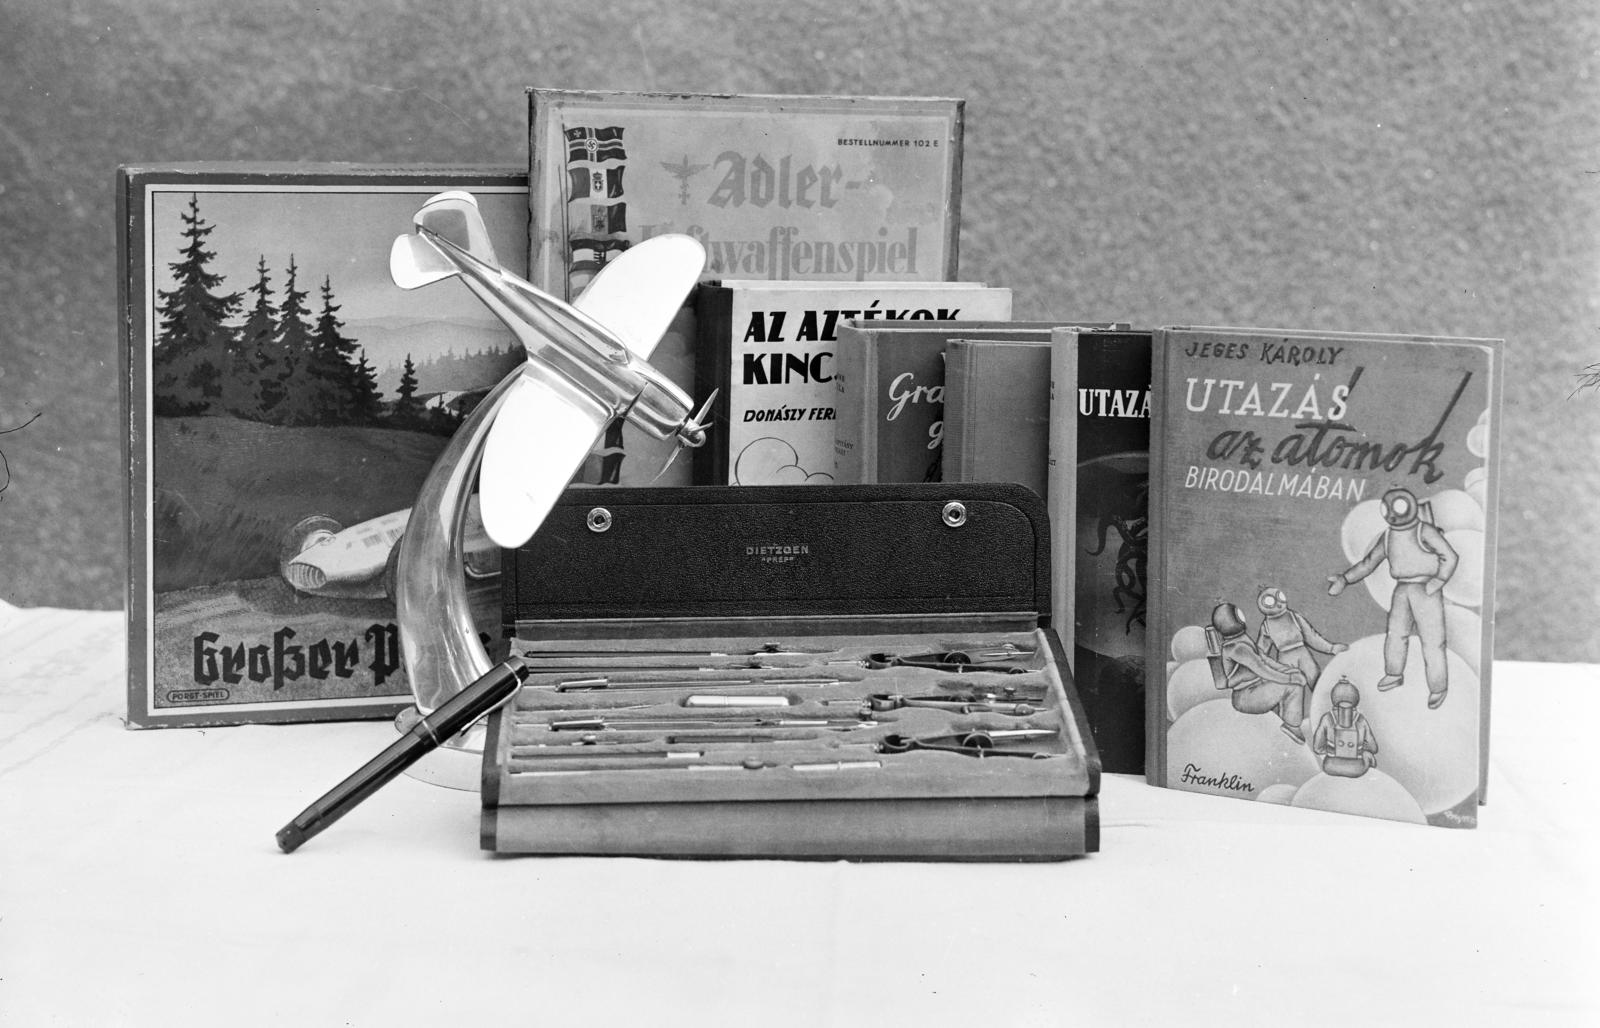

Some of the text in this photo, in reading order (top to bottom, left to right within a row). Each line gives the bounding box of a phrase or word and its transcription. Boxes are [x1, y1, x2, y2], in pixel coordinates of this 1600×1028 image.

[837, 138, 910, 147] BESTELLNUMMER
[914, 139, 930, 147] 102
[706, 150, 863, 209] Adler-
[638, 222, 919, 281] twaffenspiel
[743, 311, 786, 342] AZ
[1185, 338, 1345, 366] JEGES KÁROLY
[743, 352, 837, 384] KINC
[1185, 373, 1350, 420] UTAZÁS
[743, 404, 805, 422] DONÁSZY
[1185, 466, 1366, 502] BIRODALMÁBAN
[1180, 763, 1255, 793] Franklin
